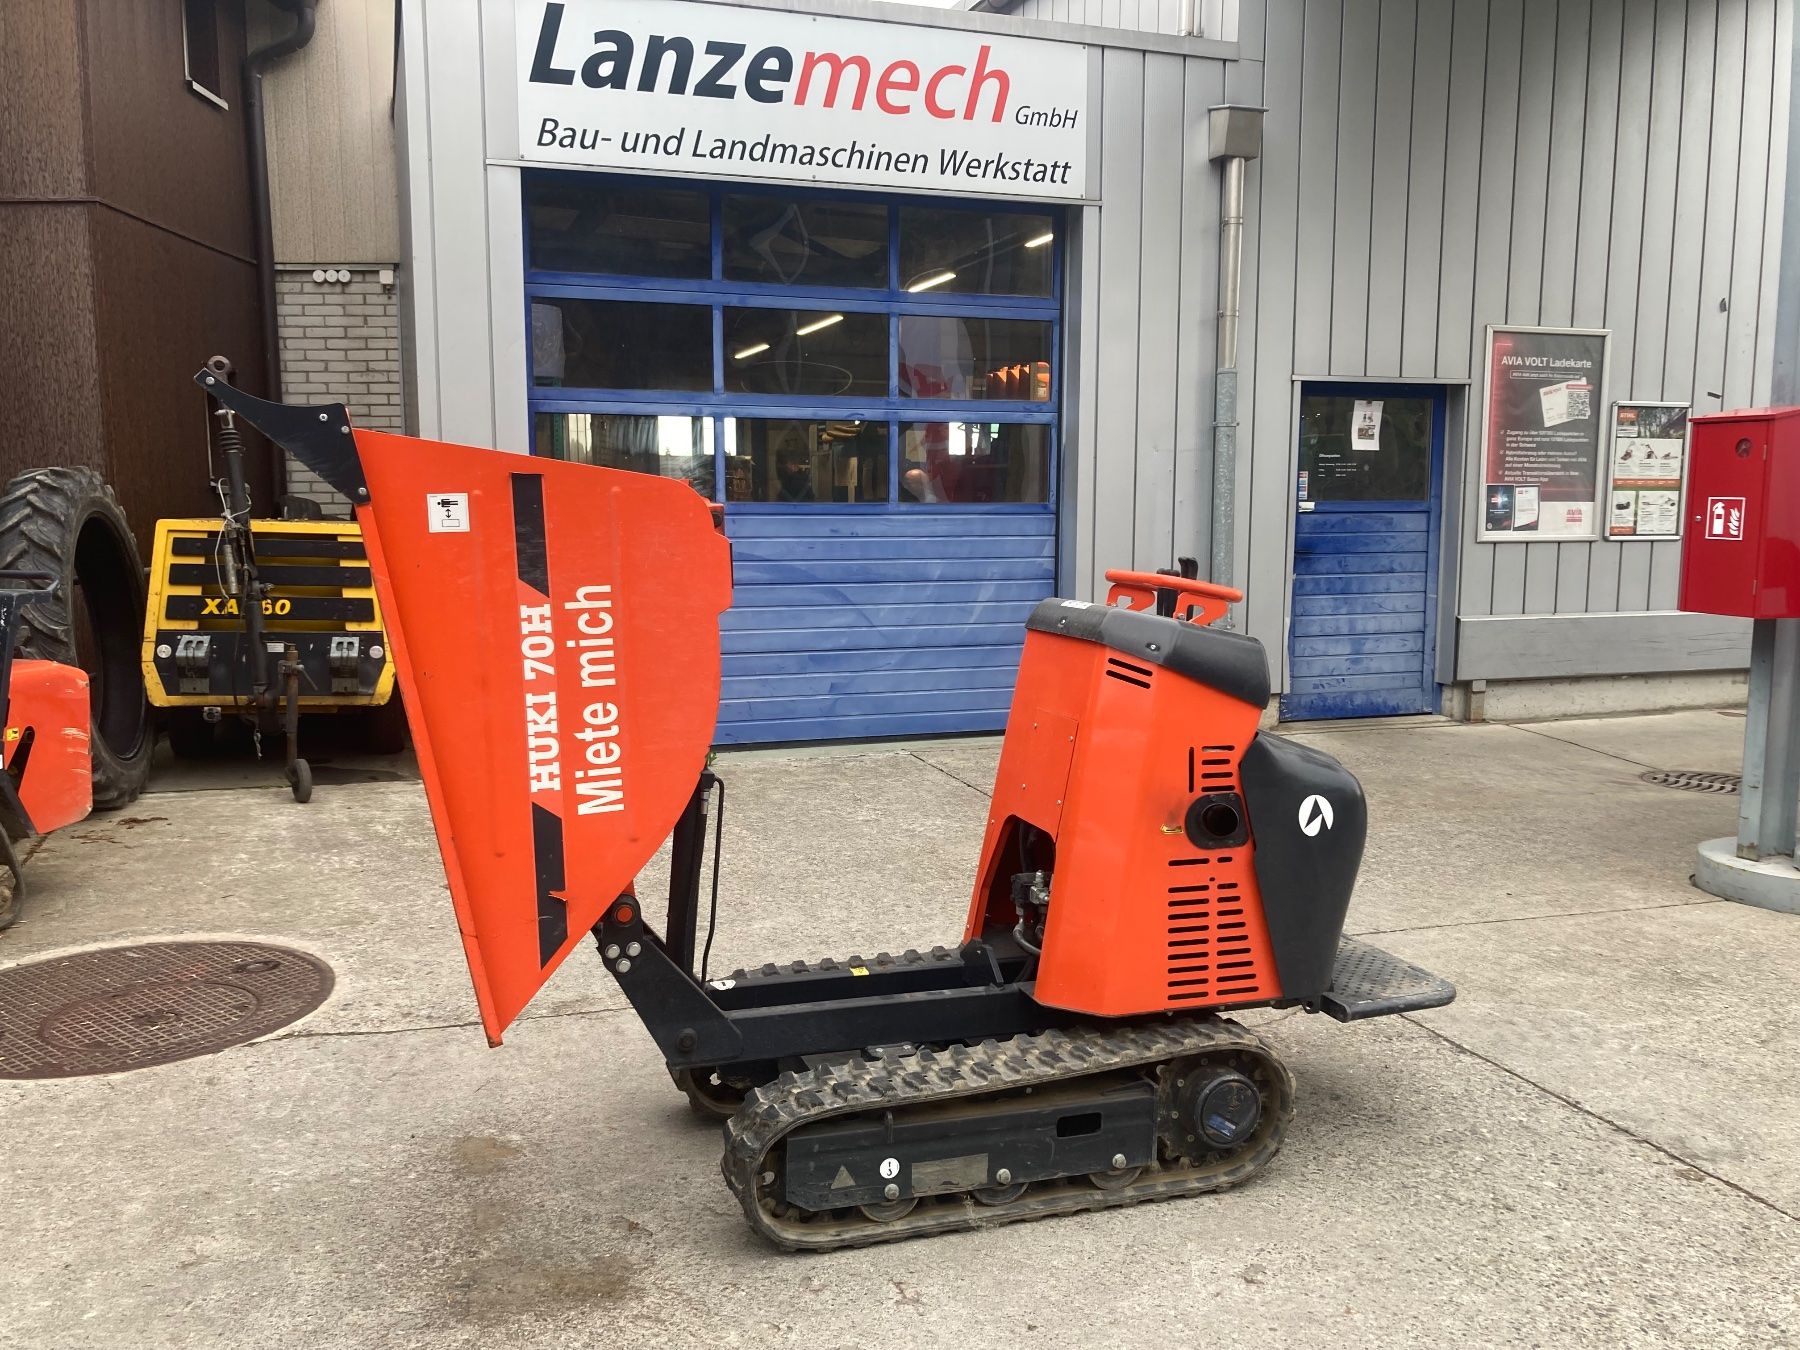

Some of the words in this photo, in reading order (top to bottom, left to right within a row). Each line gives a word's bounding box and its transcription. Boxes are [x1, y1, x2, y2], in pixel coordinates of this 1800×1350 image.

[528, 1, 1011, 124] Lanzemech
[1014, 105, 1079, 129] GmbH
[536, 117, 612, 151] Bau-
[620, 127, 686, 157] und
[691, 129, 929, 174] Landmaschinen
[939, 149, 1072, 185] Werkstatt
[1501, 356, 1523, 366] AVIA
[1524, 357, 1548, 367] VOLT
[1549, 358, 1592, 368] Ladekarte
[520, 603, 555, 681] 70H
[564, 584, 617, 688] mich
[526, 691, 561, 793] HUKI
[573, 701, 625, 816] Miete
